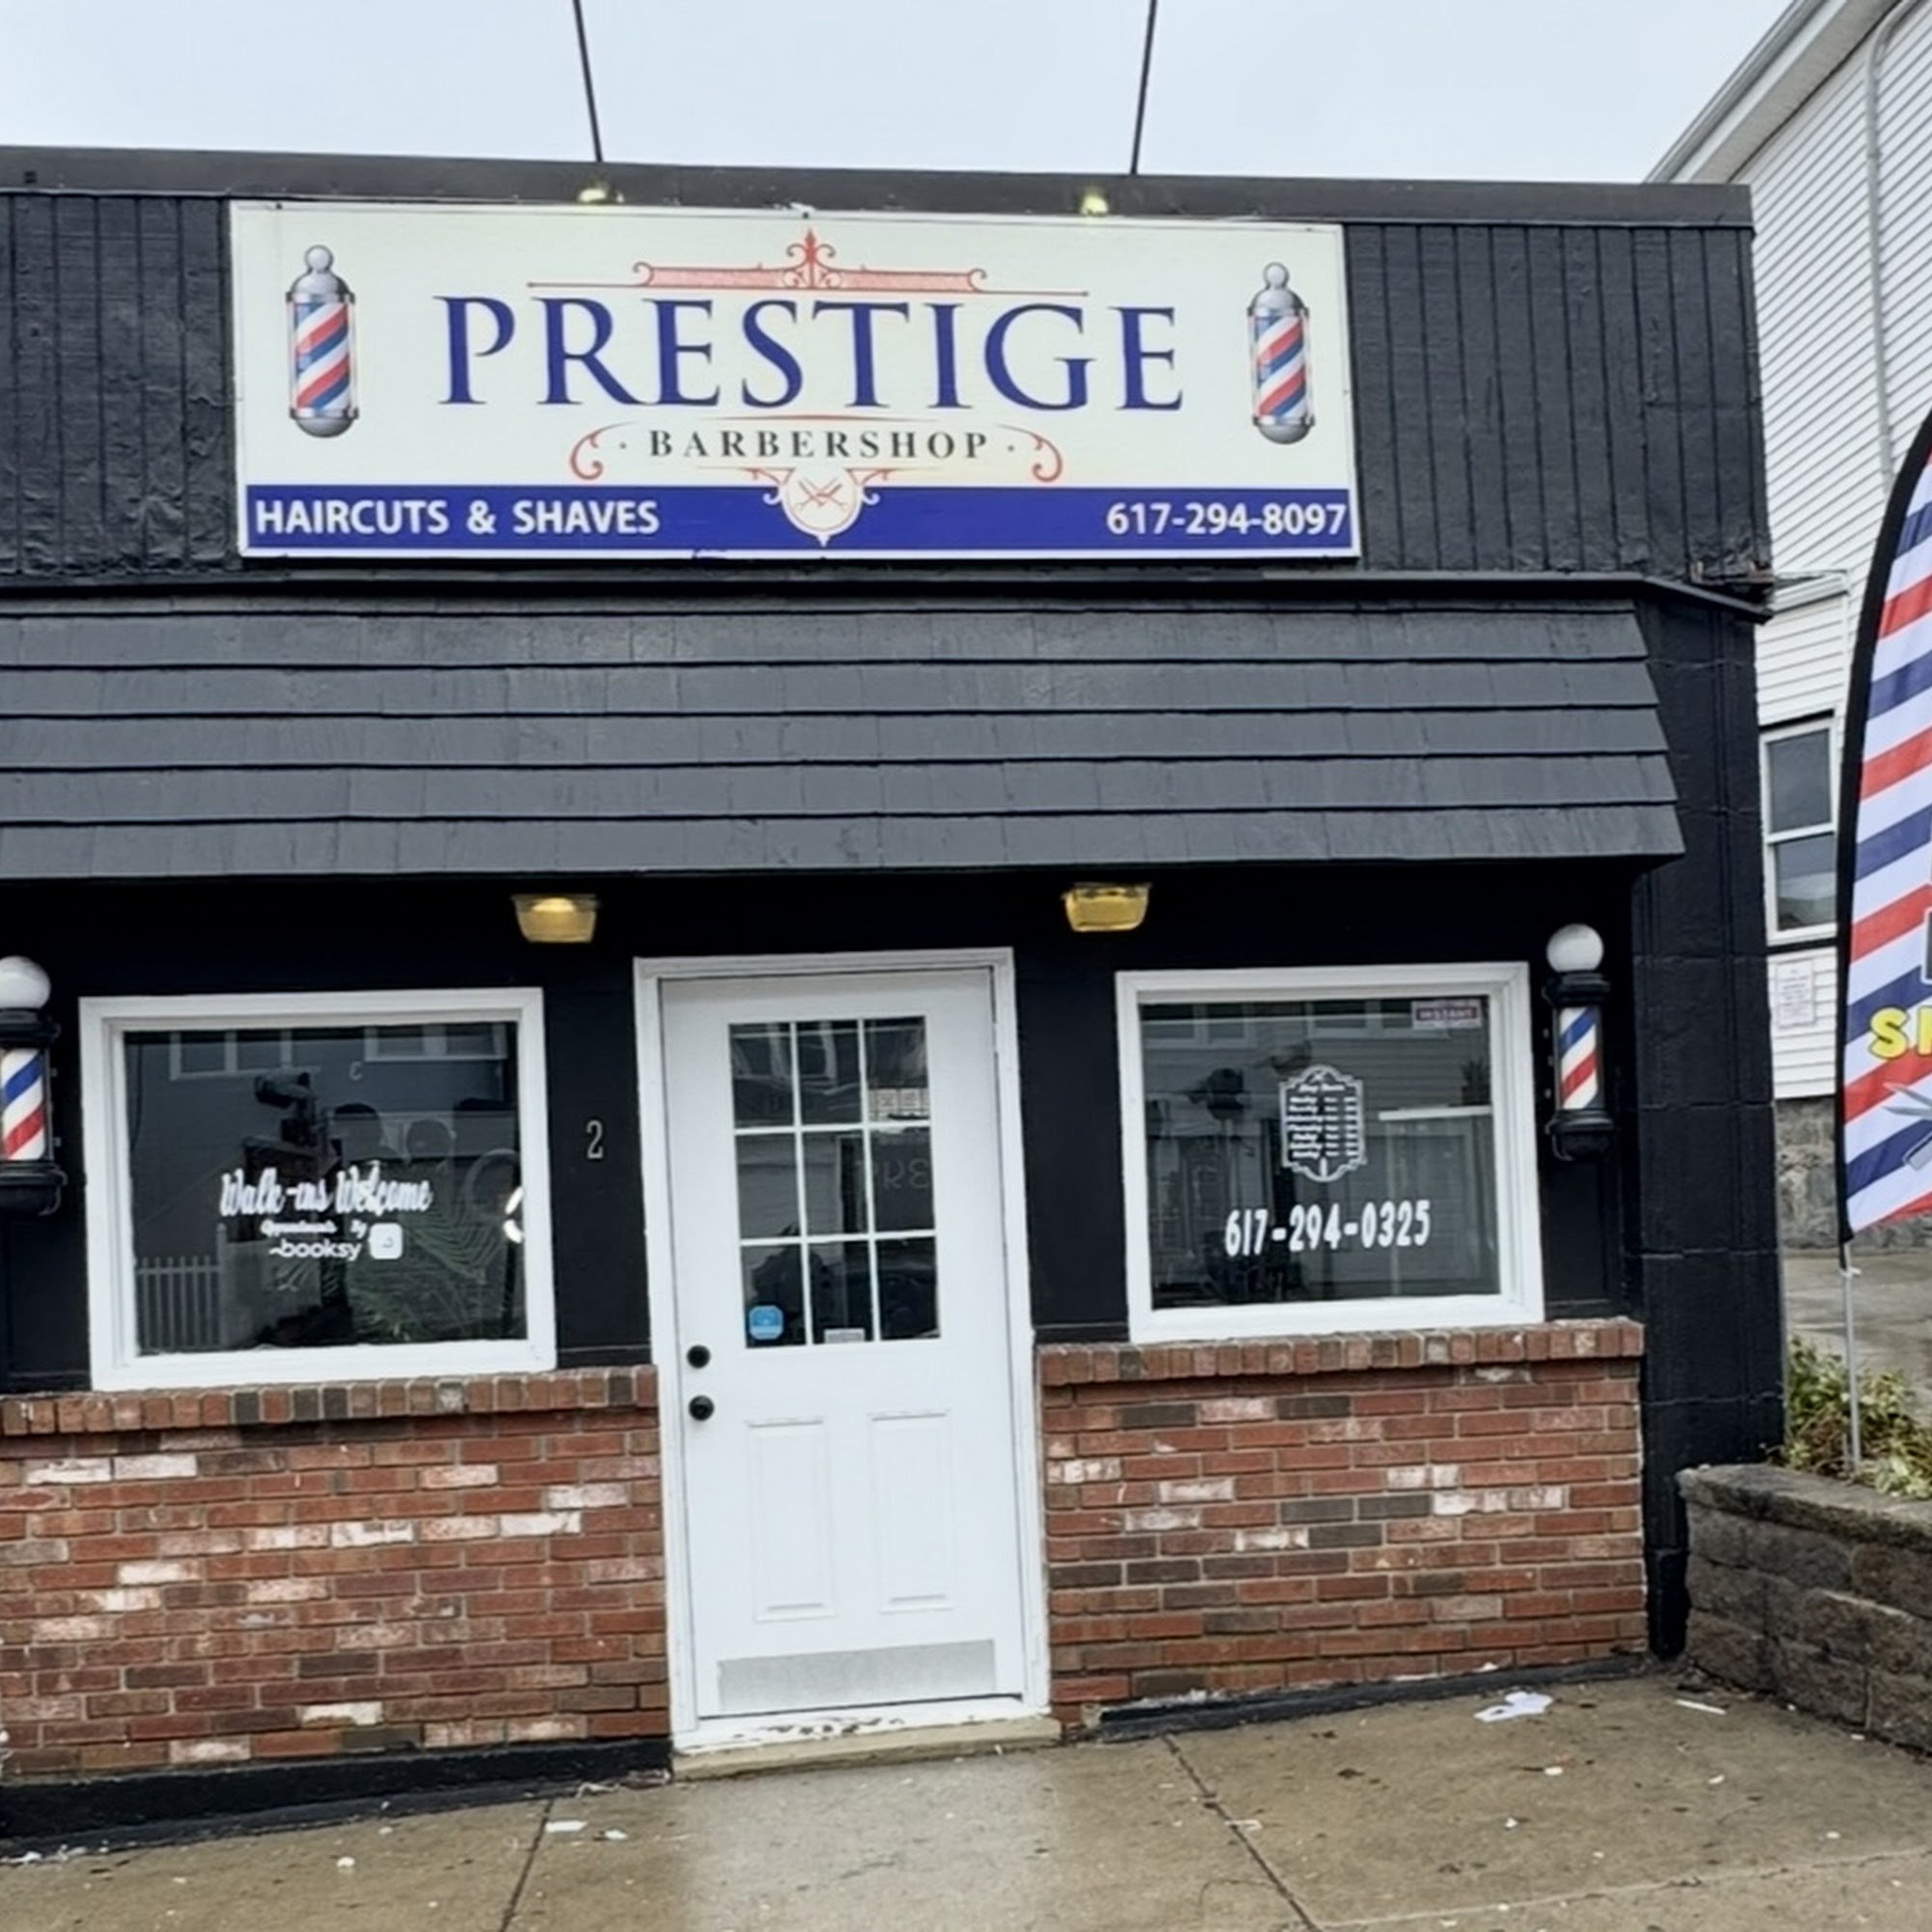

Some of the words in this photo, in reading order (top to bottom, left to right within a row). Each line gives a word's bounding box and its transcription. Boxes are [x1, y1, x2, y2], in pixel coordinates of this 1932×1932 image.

[434, 296, 1183, 412] PRESTIGE
[649, 430, 988, 460] BARBERSHOP
[255, 498, 449, 535] HAIRCUTS
[465, 499, 497, 535] &
[512, 499, 660, 536] SHAVES
[1105, 501, 1348, 536] 617-294-8097
[586, 1121, 604, 1159] 2
[335, 1160, 434, 1216] Welcome
[1224, 1200, 1431, 1257] 617-294-0325
[278, 1239, 362, 1262] booksy
